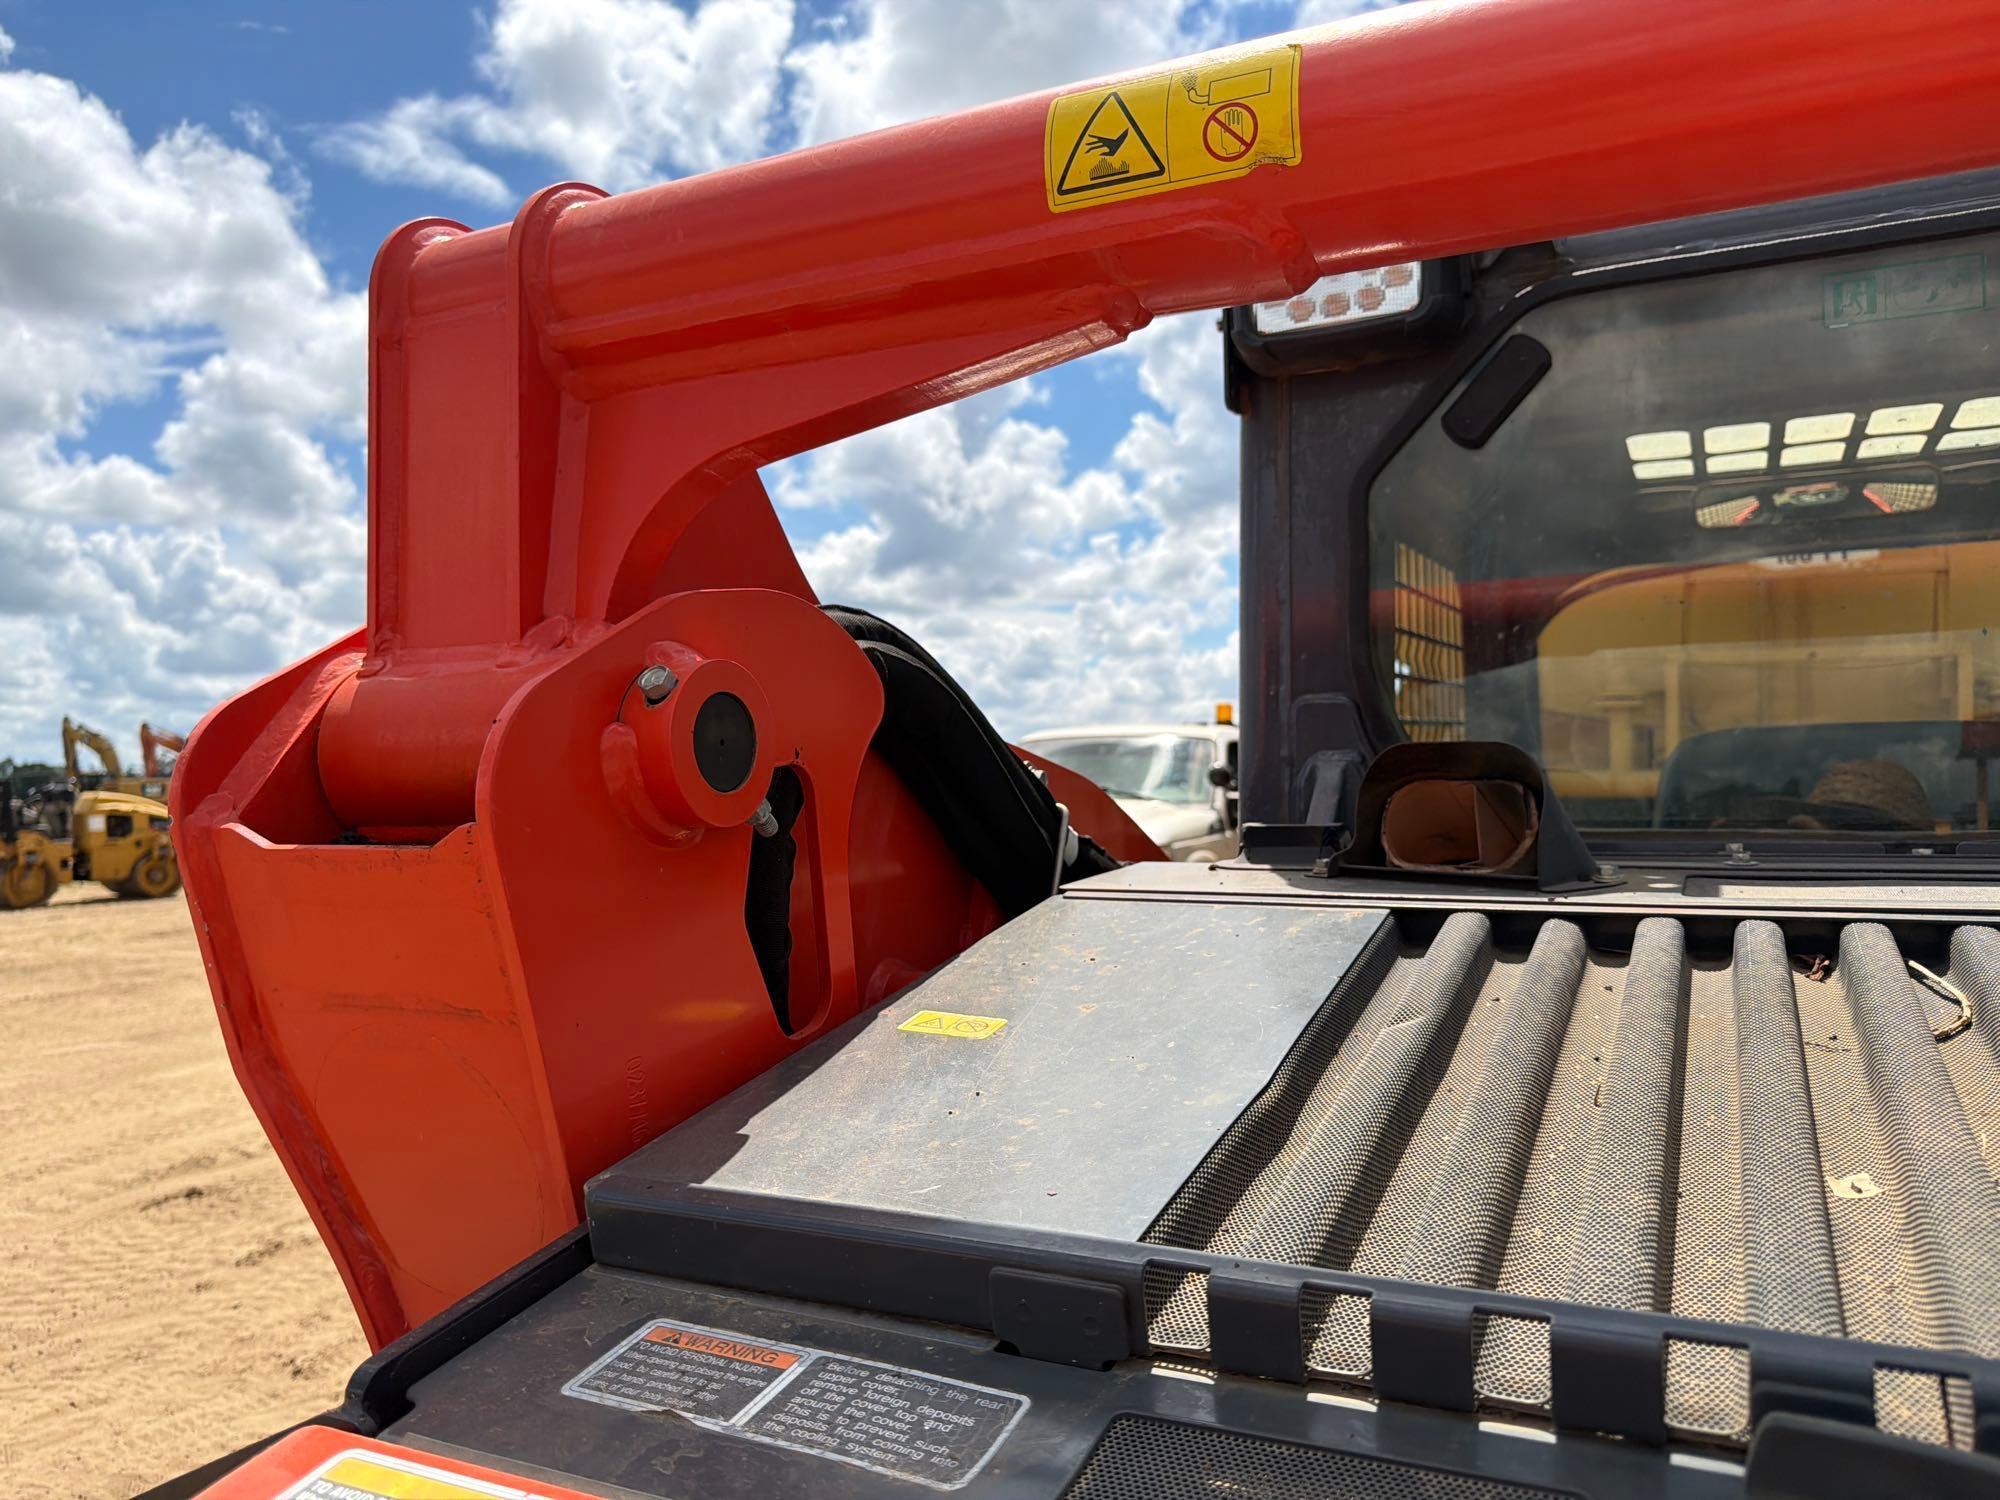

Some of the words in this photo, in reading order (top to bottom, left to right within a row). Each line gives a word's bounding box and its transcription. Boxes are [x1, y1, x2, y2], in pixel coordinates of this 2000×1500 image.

[637, 1340, 649, 1350] TO
[650, 1344, 679, 1356] AVOID
[680, 1350, 728, 1368] PERSONAL
[685, 1335, 780, 1363] WARNING
[599, 1371, 622, 1380] your
[618, 1373, 647, 1386] hands
[643, 1380, 684, 1395] pinched
[681, 1388, 695, 1396] or
[623, 1350, 648, 1361] When
[646, 1356, 680, 1370] opening
[677, 1363, 696, 1373] and
[723, 1372, 739, 1381] the
[737, 1376, 768, 1389] engine
[649, 1369, 684, 1380] careful
[680, 1374, 698, 1384] not
[695, 1379, 708, 1387] to
[817, 1371, 858, 1384] upper
[608, 1384, 622, 1393] of
[619, 1388, 643, 1397] your
[639, 1391, 664, 1403] body
[826, 1361, 871, 1377] Before
[874, 1373, 939, 1396] detaching
[944, 1389, 970, 1402] the
[974, 1399, 1007, 1411] rear
[791, 1396, 841, 1413] around
[843, 1406, 867, 1419] the
[800, 1387, 822, 1397] off
[823, 1391, 847, 1404] the
[850, 1399, 890, 1414] cover
[895, 1409, 919, 1423] top
[922, 1419, 955, 1433] and
[808, 1379, 860, 1396] remove
[863, 1390, 912, 1409] foreign
[917, 1405, 976, 1427] deposits
[763, 1420, 787, 1433] the
[790, 1428, 841, 1447] cooling
[844, 1441, 899, 1464] system.
[772, 1413, 830, 1433] deposits
[834, 1427, 868, 1442] from
[871, 1438, 926, 1461] coming
[930, 1454, 960, 1469] into
[783, 1402, 812, 1417] This
[816, 1410, 831, 1422] is
[835, 1415, 851, 1426] to
[853, 1422, 910, 1443] prevent
[914, 1440, 951, 1456] such
[311, 1480, 334, 1494] TO
